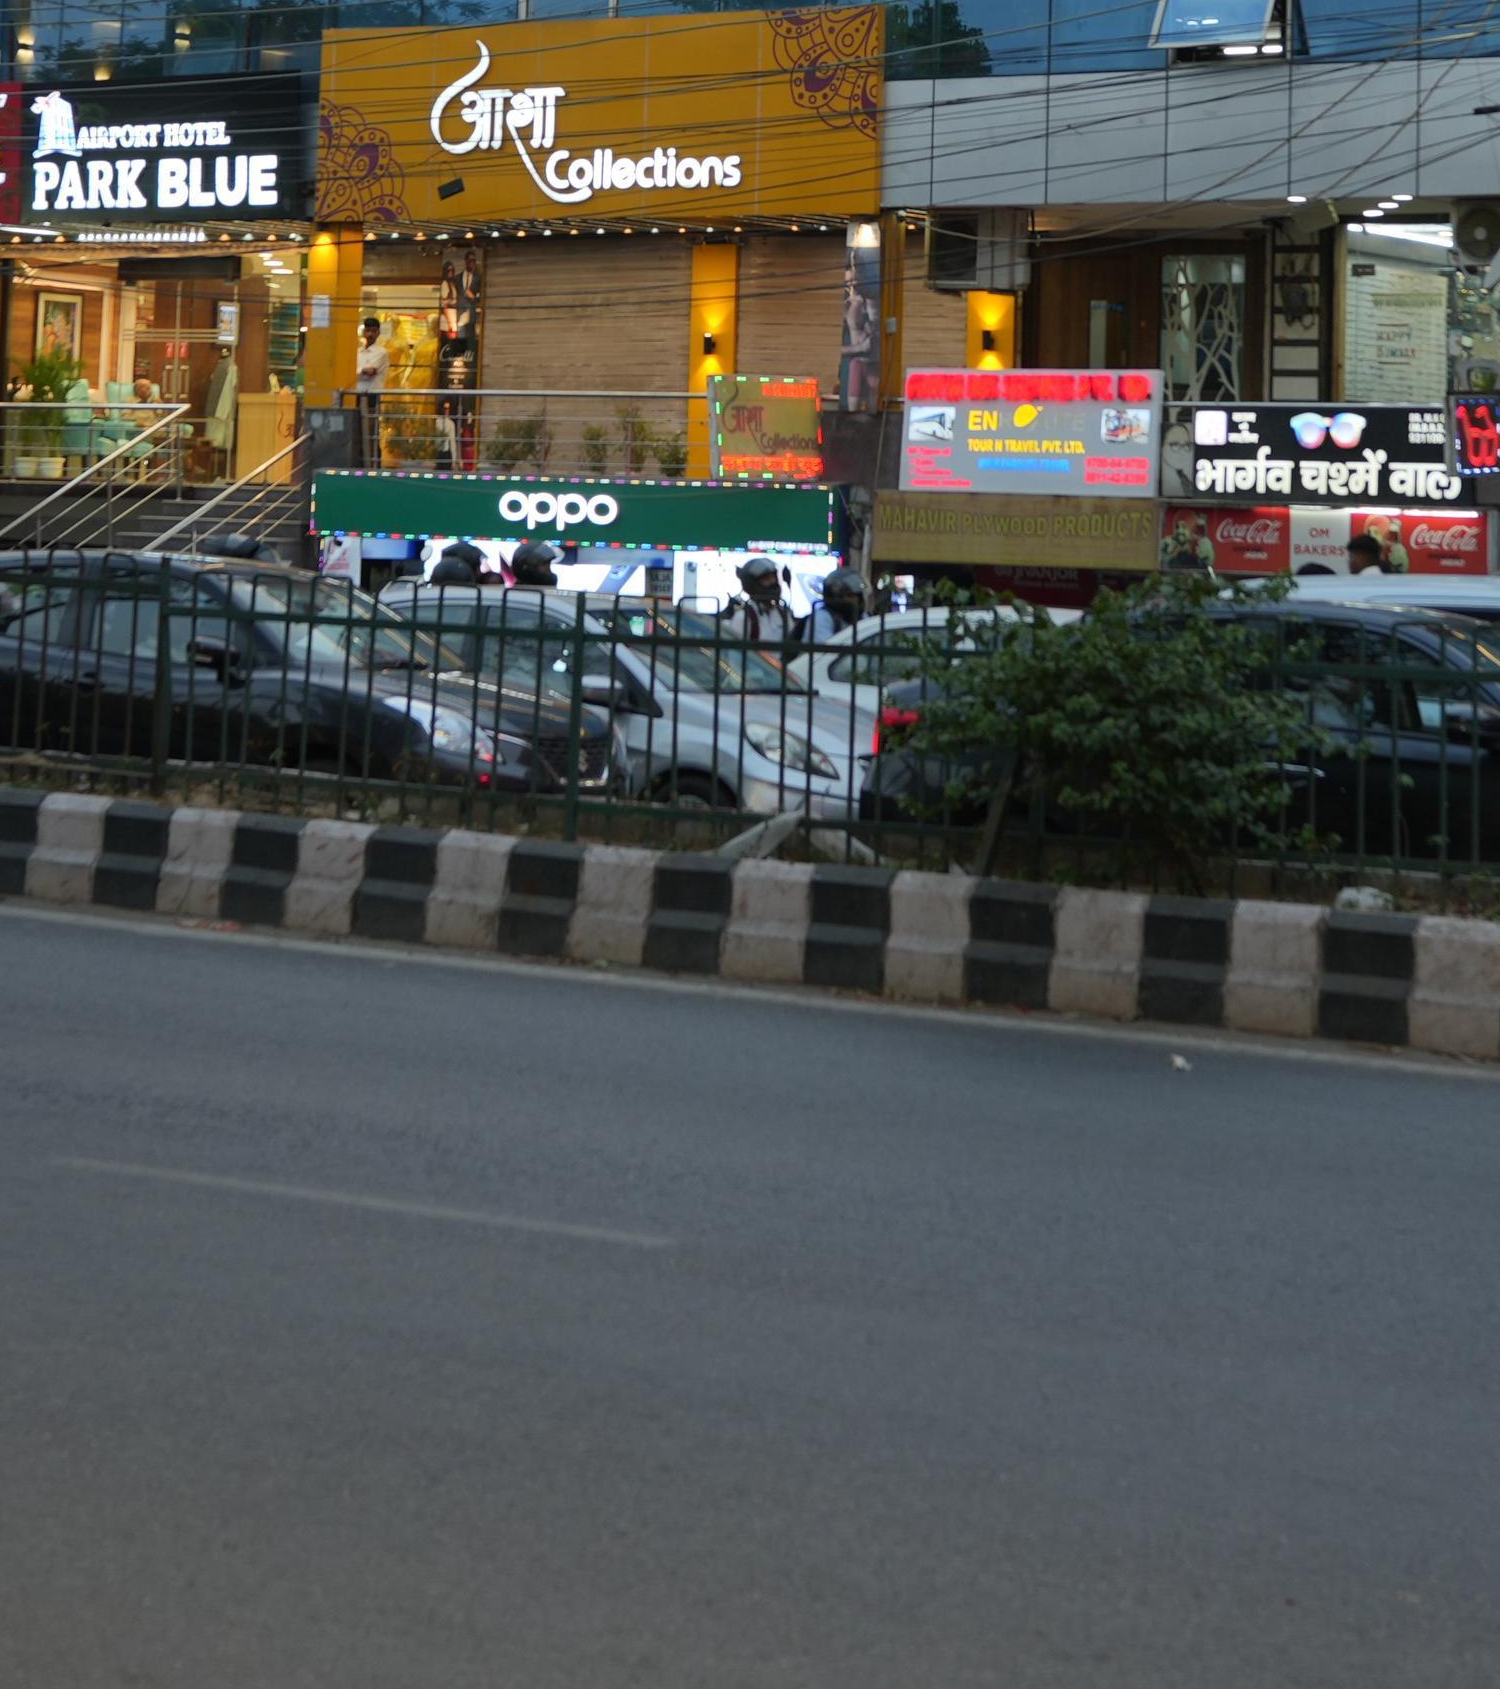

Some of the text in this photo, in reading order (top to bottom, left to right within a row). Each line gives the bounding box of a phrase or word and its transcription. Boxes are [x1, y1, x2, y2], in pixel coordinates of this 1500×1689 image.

[77, 121, 231, 149] AIRPORT HOTEL
[32, 159, 147, 210] PARK
[157, 154, 278, 208] BLUE
[546, 146, 741, 189] Collections
[967, 409, 999, 432] EN
[967, 439, 995, 453] TOUR
[1004, 440, 1041, 454] TRAVEL
[1195, 445, 1295, 494] भार्गव
[878, 504, 1152, 538] MAHAVIR PLYWOOD PRODUCTS
[1308, 527, 1330, 539] OM
